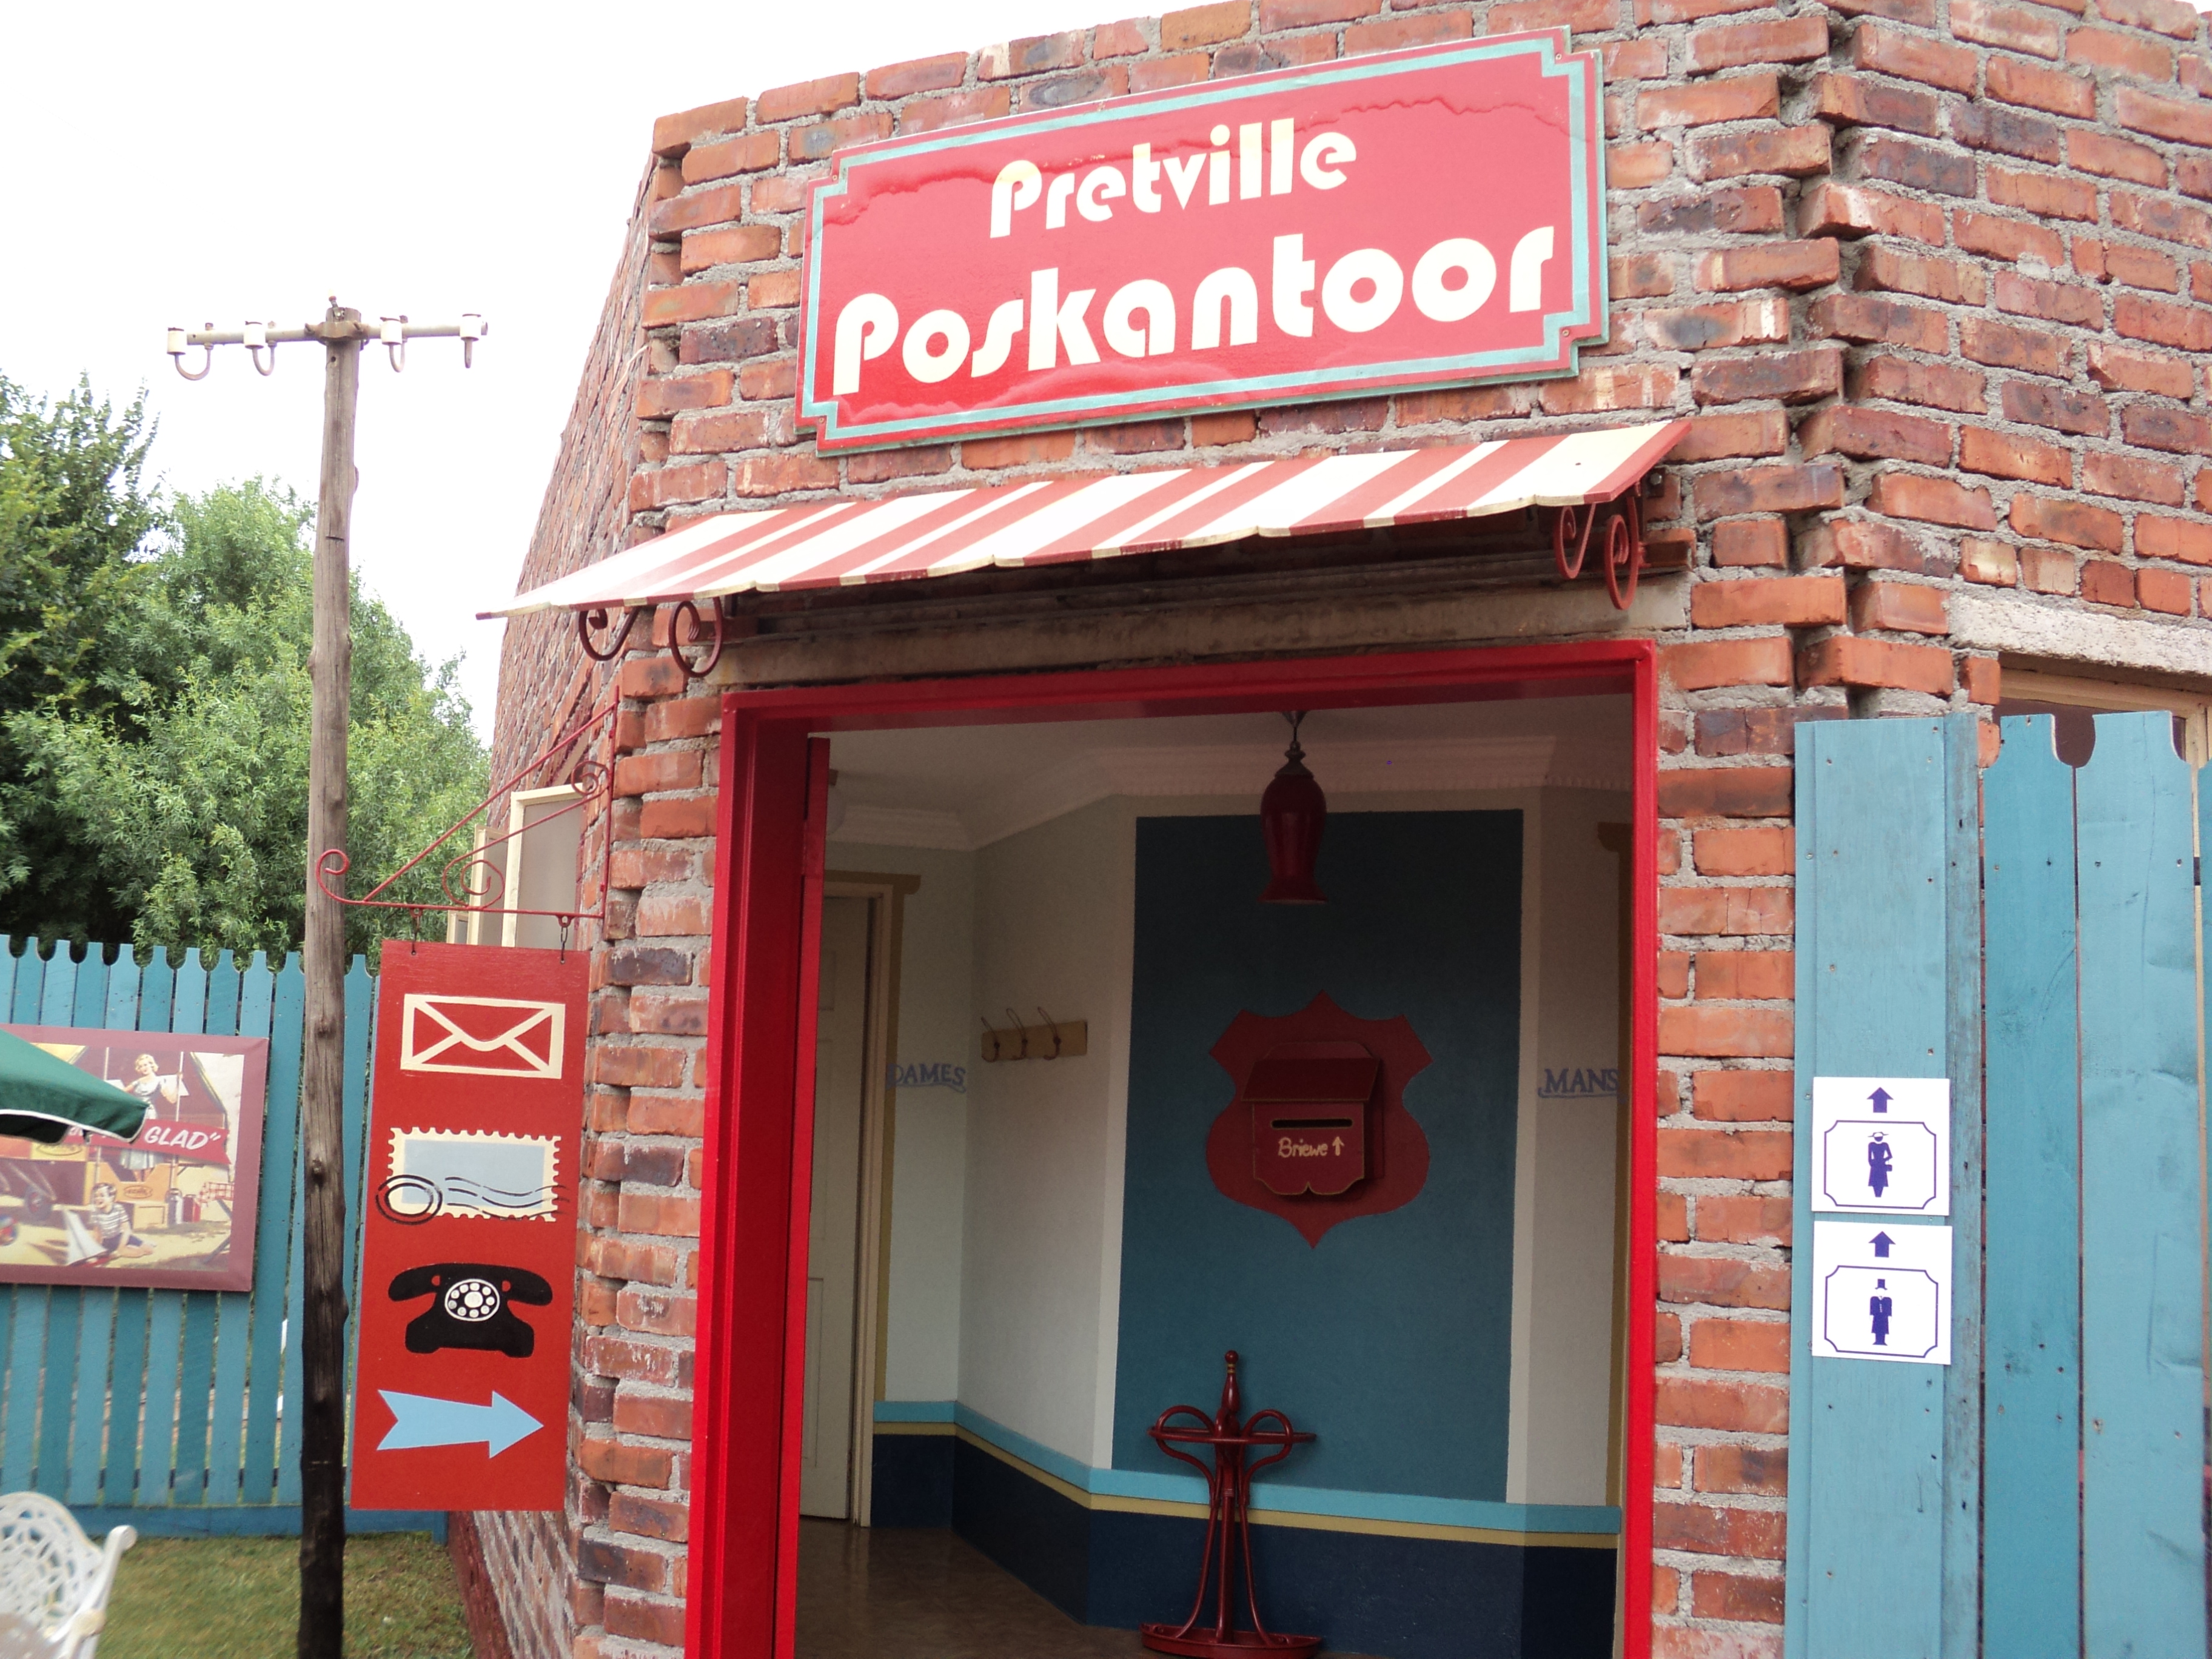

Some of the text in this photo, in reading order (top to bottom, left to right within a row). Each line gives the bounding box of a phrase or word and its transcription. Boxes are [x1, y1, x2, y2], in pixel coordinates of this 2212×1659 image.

[990, 118, 1357, 238] Pretville
[833, 226, 1554, 395] Poskantoor
[887, 1062, 966, 1087] DAMES
[1544, 1068, 1621, 1093] MANS
[1278, 1137, 1328, 1158] Briewe
